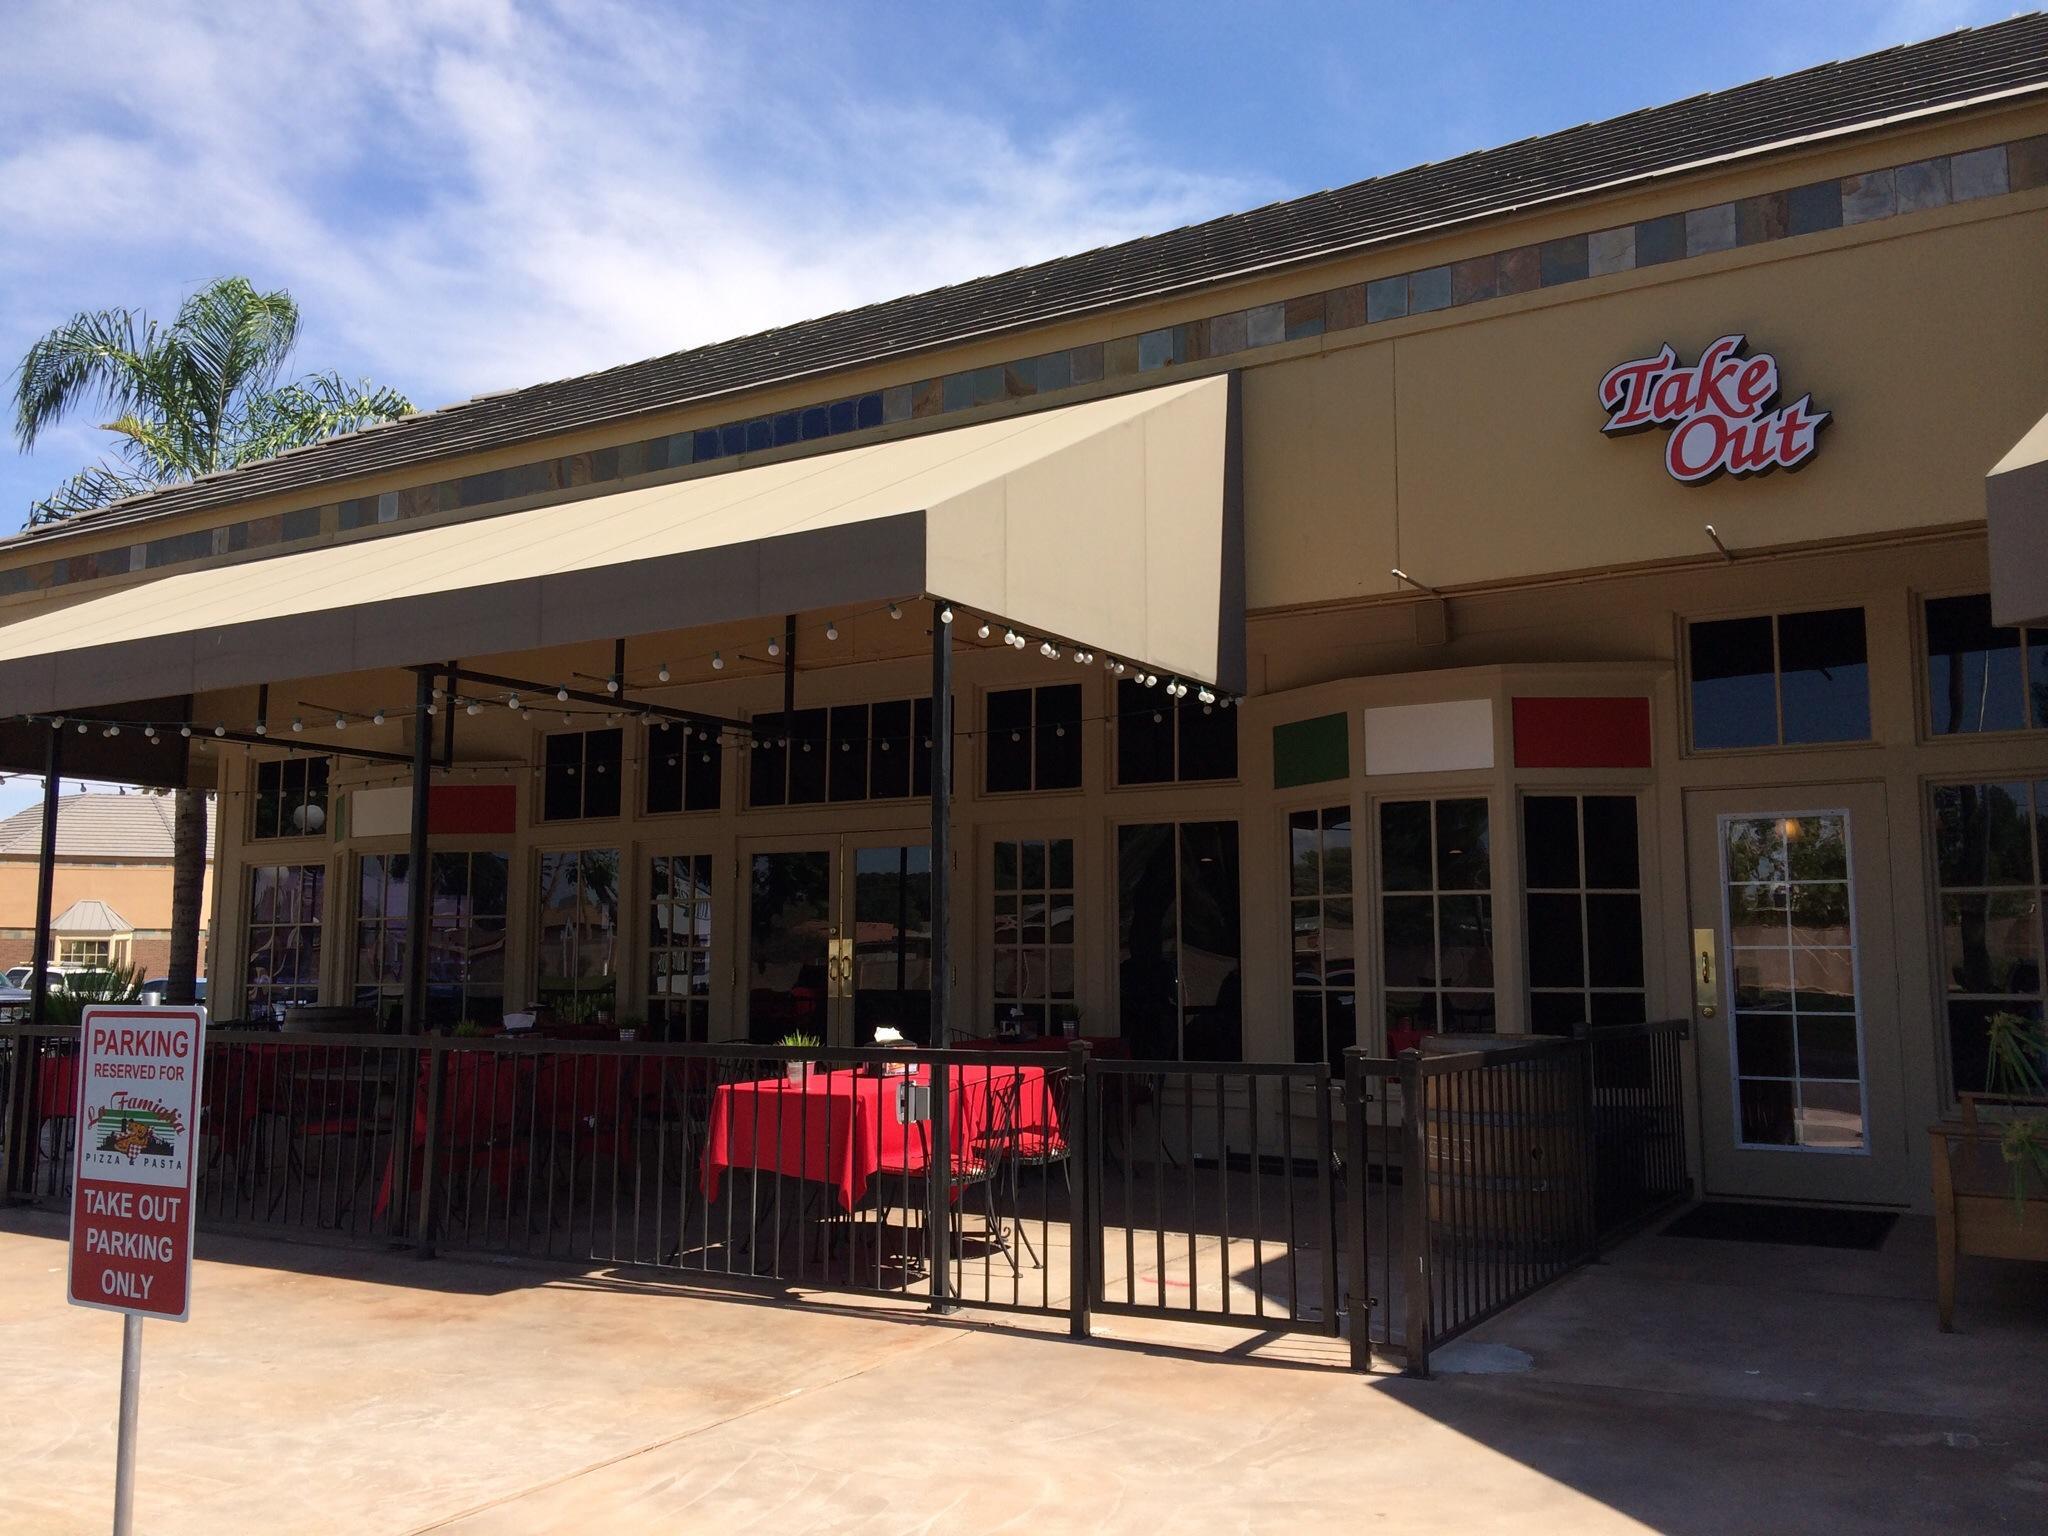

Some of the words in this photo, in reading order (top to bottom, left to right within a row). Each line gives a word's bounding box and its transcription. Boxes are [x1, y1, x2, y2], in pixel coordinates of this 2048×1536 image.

[1604, 341, 1772, 425] Take
[1670, 411, 1812, 477] Out
[93, 1029, 189, 1058] PARKING
[94, 1063, 156, 1080] RESERVED
[159, 1065, 184, 1081] FOR
[87, 1105, 107, 1130] La
[110, 1091, 186, 1137] Famiglia
[85, 1152, 121, 1165] PIZZA
[143, 1157, 182, 1170] PASTA
[84, 1189, 133, 1218] TAKE
[138, 1194, 181, 1223] OUT
[86, 1227, 173, 1263] PARKING
[101, 1268, 154, 1300] ONLY
